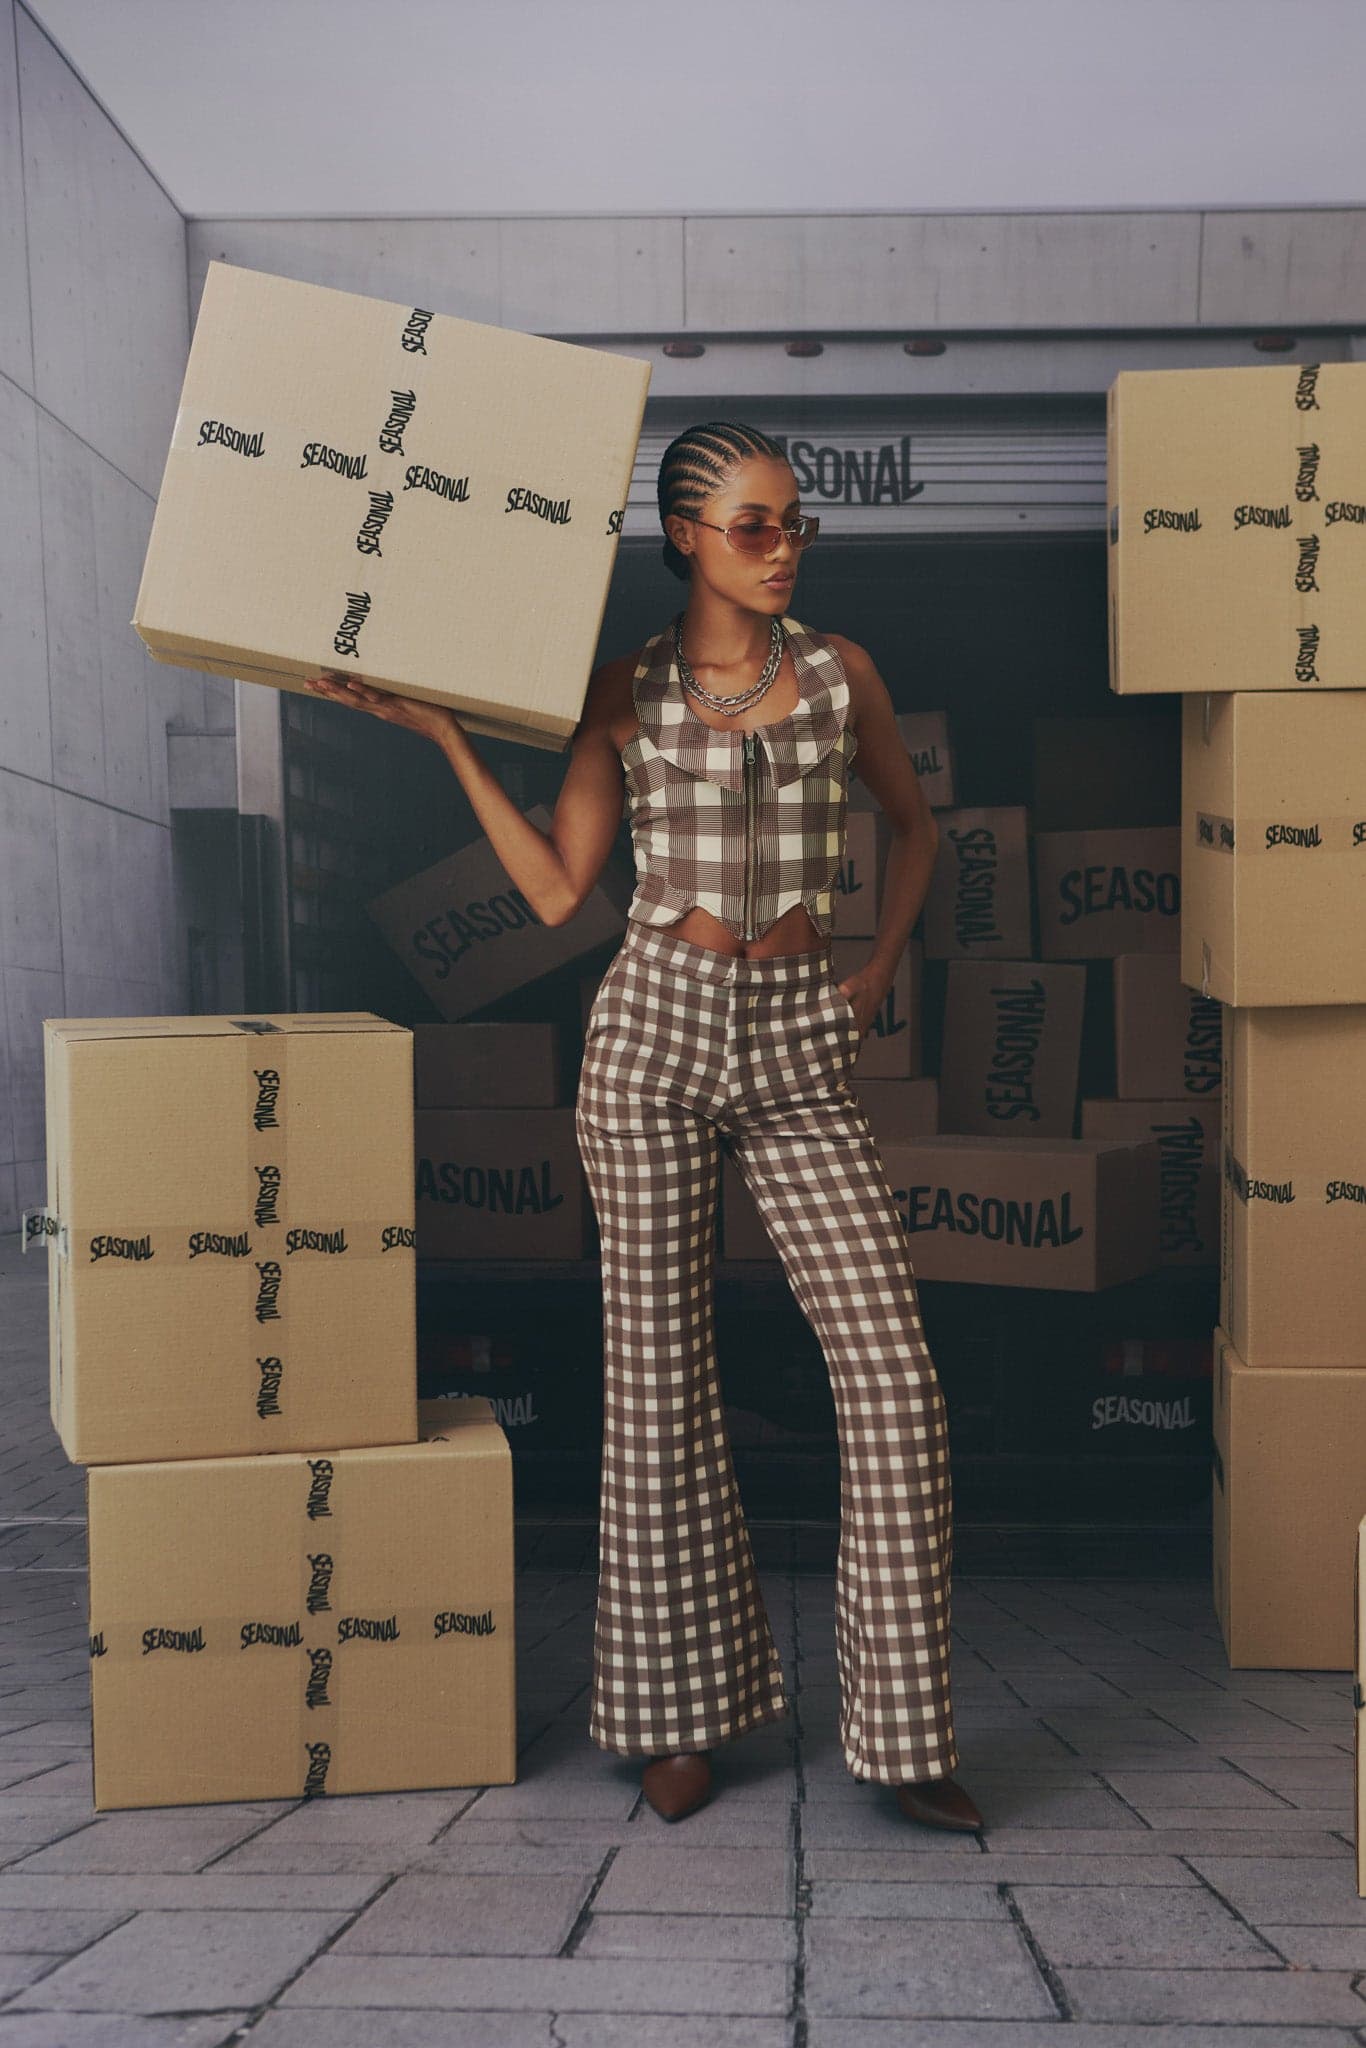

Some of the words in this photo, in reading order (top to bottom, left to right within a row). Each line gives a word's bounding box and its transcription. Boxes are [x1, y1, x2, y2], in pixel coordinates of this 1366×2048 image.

[1295, 364, 1320, 411] SEASON
[198, 421, 265, 457] SEASONAL
[301, 443, 367, 480] SEASONAL
[403, 466, 470, 502] SEASONAL
[505, 488, 571, 524] SEASONAL
[334, 592, 371, 658] SEASONAL
[357, 491, 393, 557] SEASONAL
[380, 390, 416, 456] SEASONAL
[402, 308, 434, 355] SEASO
[774, 436, 924, 506] SONAL
[1296, 444, 1320, 502] SEASONAL
[1144, 509, 1201, 533] SEASONAL
[1234, 505, 1292, 530] SEASONAL
[1295, 535, 1320, 592] SEASONAL
[1295, 625, 1319, 681] SEASONAL
[1266, 825, 1321, 849] SEASONAL
[948, 828, 1003, 948] SEASONAL
[1059, 866, 1181, 925] SEASO
[413, 889, 543, 979] SEASO
[986, 979, 1047, 1122] SEASONAL
[1183, 995, 1222, 1093] SEASON
[254, 1070, 280, 1132] SEASONAL
[255, 1166, 280, 1228] SEASONAL
[416, 1158, 564, 1216] ASONAL
[1150, 1116, 1205, 1252] SEASONAL
[1246, 1180, 1296, 1205] EASONAL
[1326, 1180, 1366, 1206] SEASON
[27, 1215, 60, 1241] SEAS
[91, 1235, 154, 1262] SEASONAL
[190, 1232, 252, 1258] SEASONAL
[286, 1229, 348, 1255] SEASONAL
[382, 1226, 416, 1252] SEAS
[892, 1186, 1083, 1249] EASONAL
[255, 1262, 281, 1323] SEASONAL
[256, 1357, 282, 1419] SEASONAL
[1092, 1396, 1196, 1430] SEASONAL
[307, 1460, 333, 1520] SEASONAL
[307, 1554, 333, 1615] SEASONAL
[143, 1627, 206, 1655] SEASONAL
[241, 1622, 303, 1649] SEASONAL
[338, 1616, 400, 1644] SEASONAL
[435, 1611, 496, 1638] SEASONAL
[306, 1649, 332, 1709] SEASONAL
